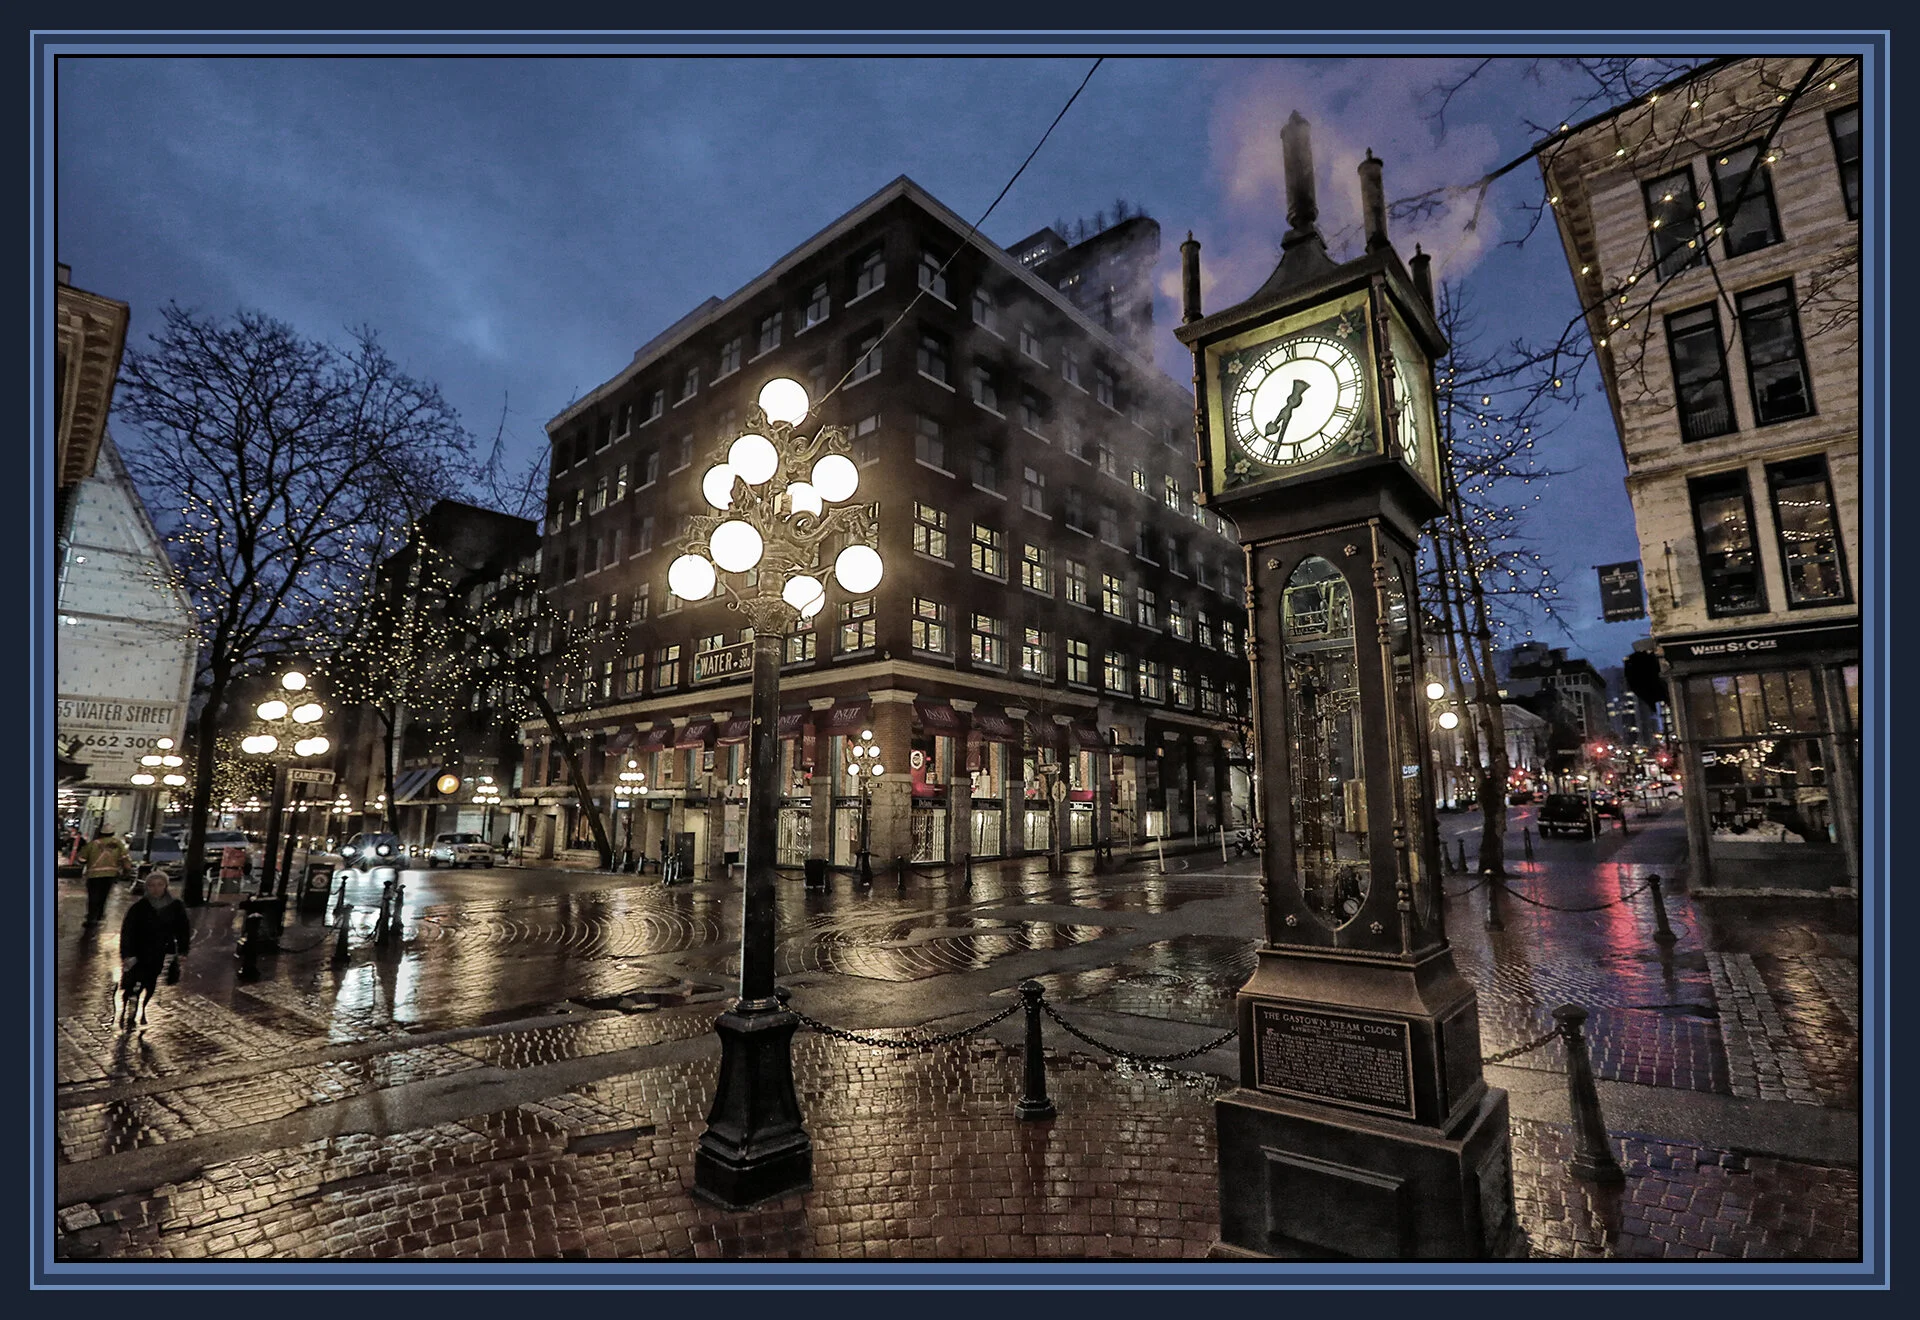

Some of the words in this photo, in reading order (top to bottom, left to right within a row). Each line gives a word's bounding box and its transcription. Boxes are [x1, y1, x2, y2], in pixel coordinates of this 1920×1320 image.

[700, 652, 733, 676] WATER
[741, 648, 748, 658] ST
[739, 658, 751, 669] 300
[75, 703, 122, 721] WATER
[126, 706, 173, 724] STREET
[85, 735, 118, 748] 662
[1263, 1011, 1280, 1021] THE
[1282, 1013, 1327, 1027] GASTOWN
[1330, 1020, 1360, 1032] STEAM
[1363, 1025, 1397, 1037] CLOCK
